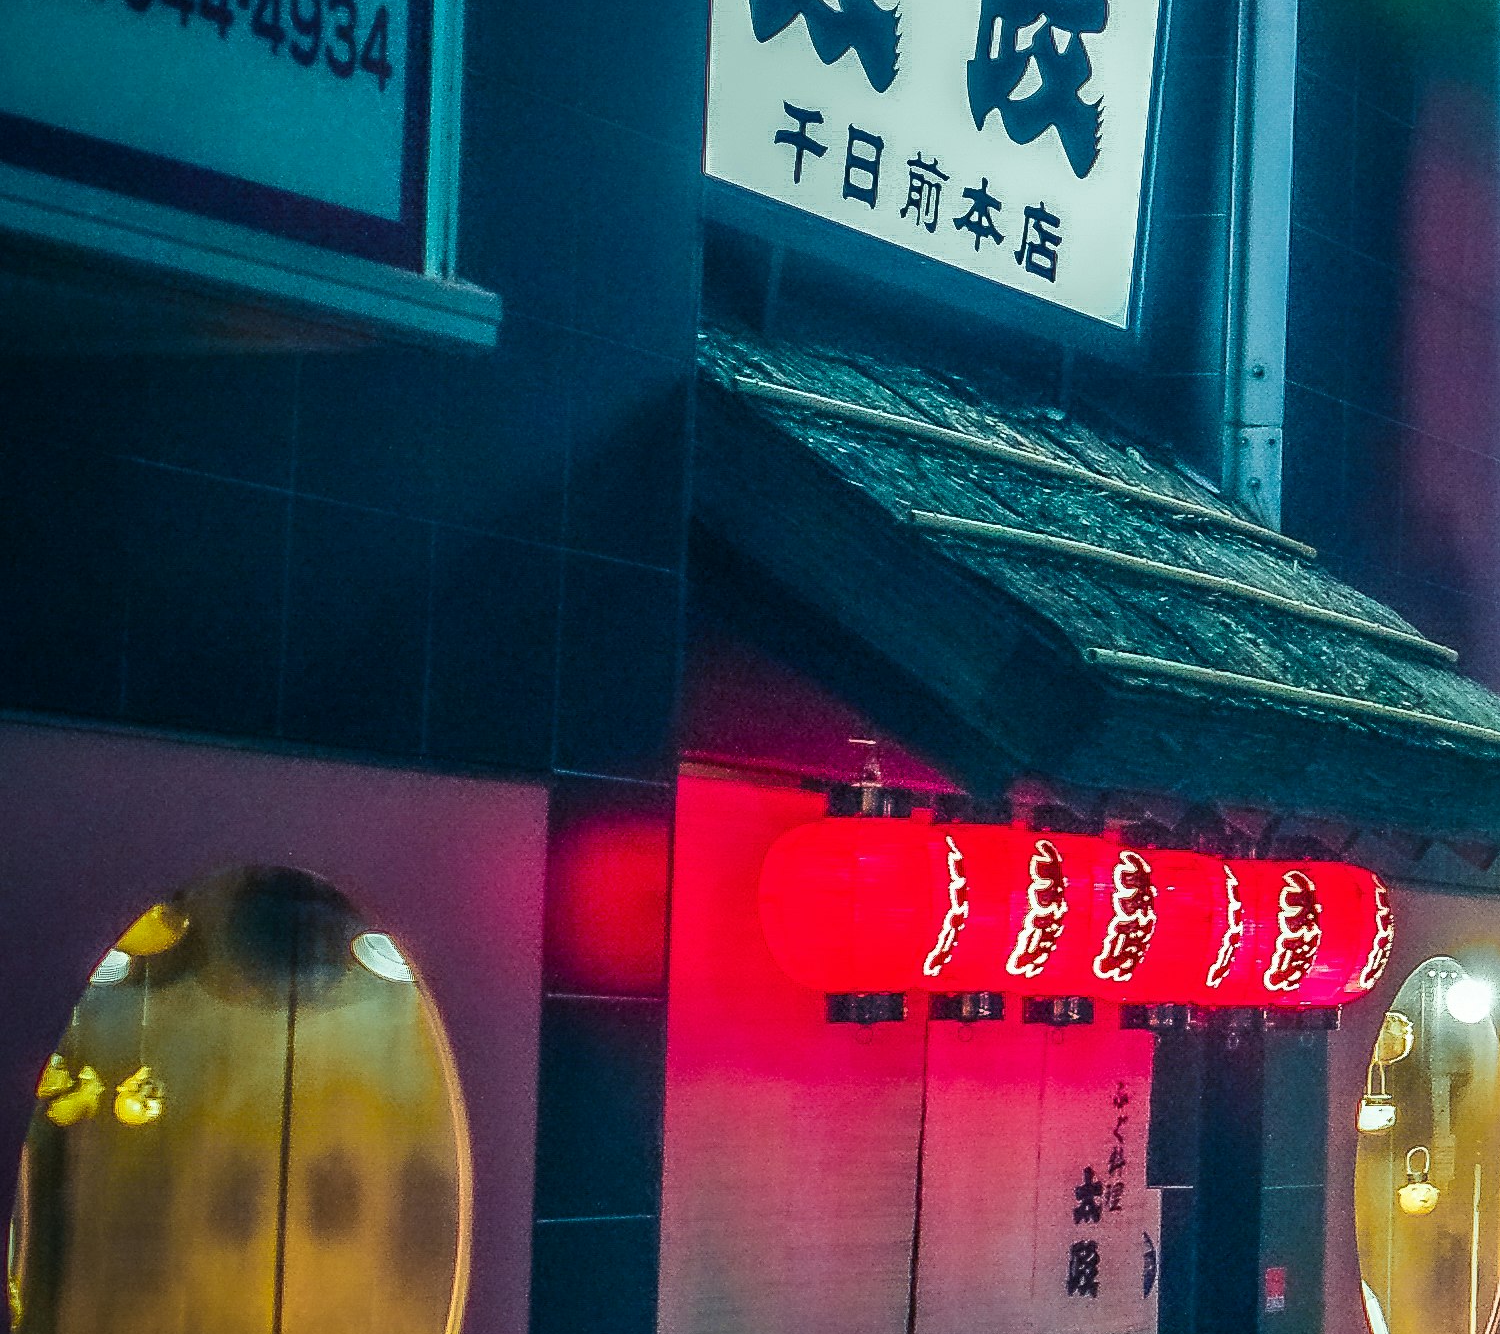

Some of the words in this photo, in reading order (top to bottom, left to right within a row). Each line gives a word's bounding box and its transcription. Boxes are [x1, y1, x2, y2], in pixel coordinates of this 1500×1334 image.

[775, 102, 1061, 285] 千日前本店
